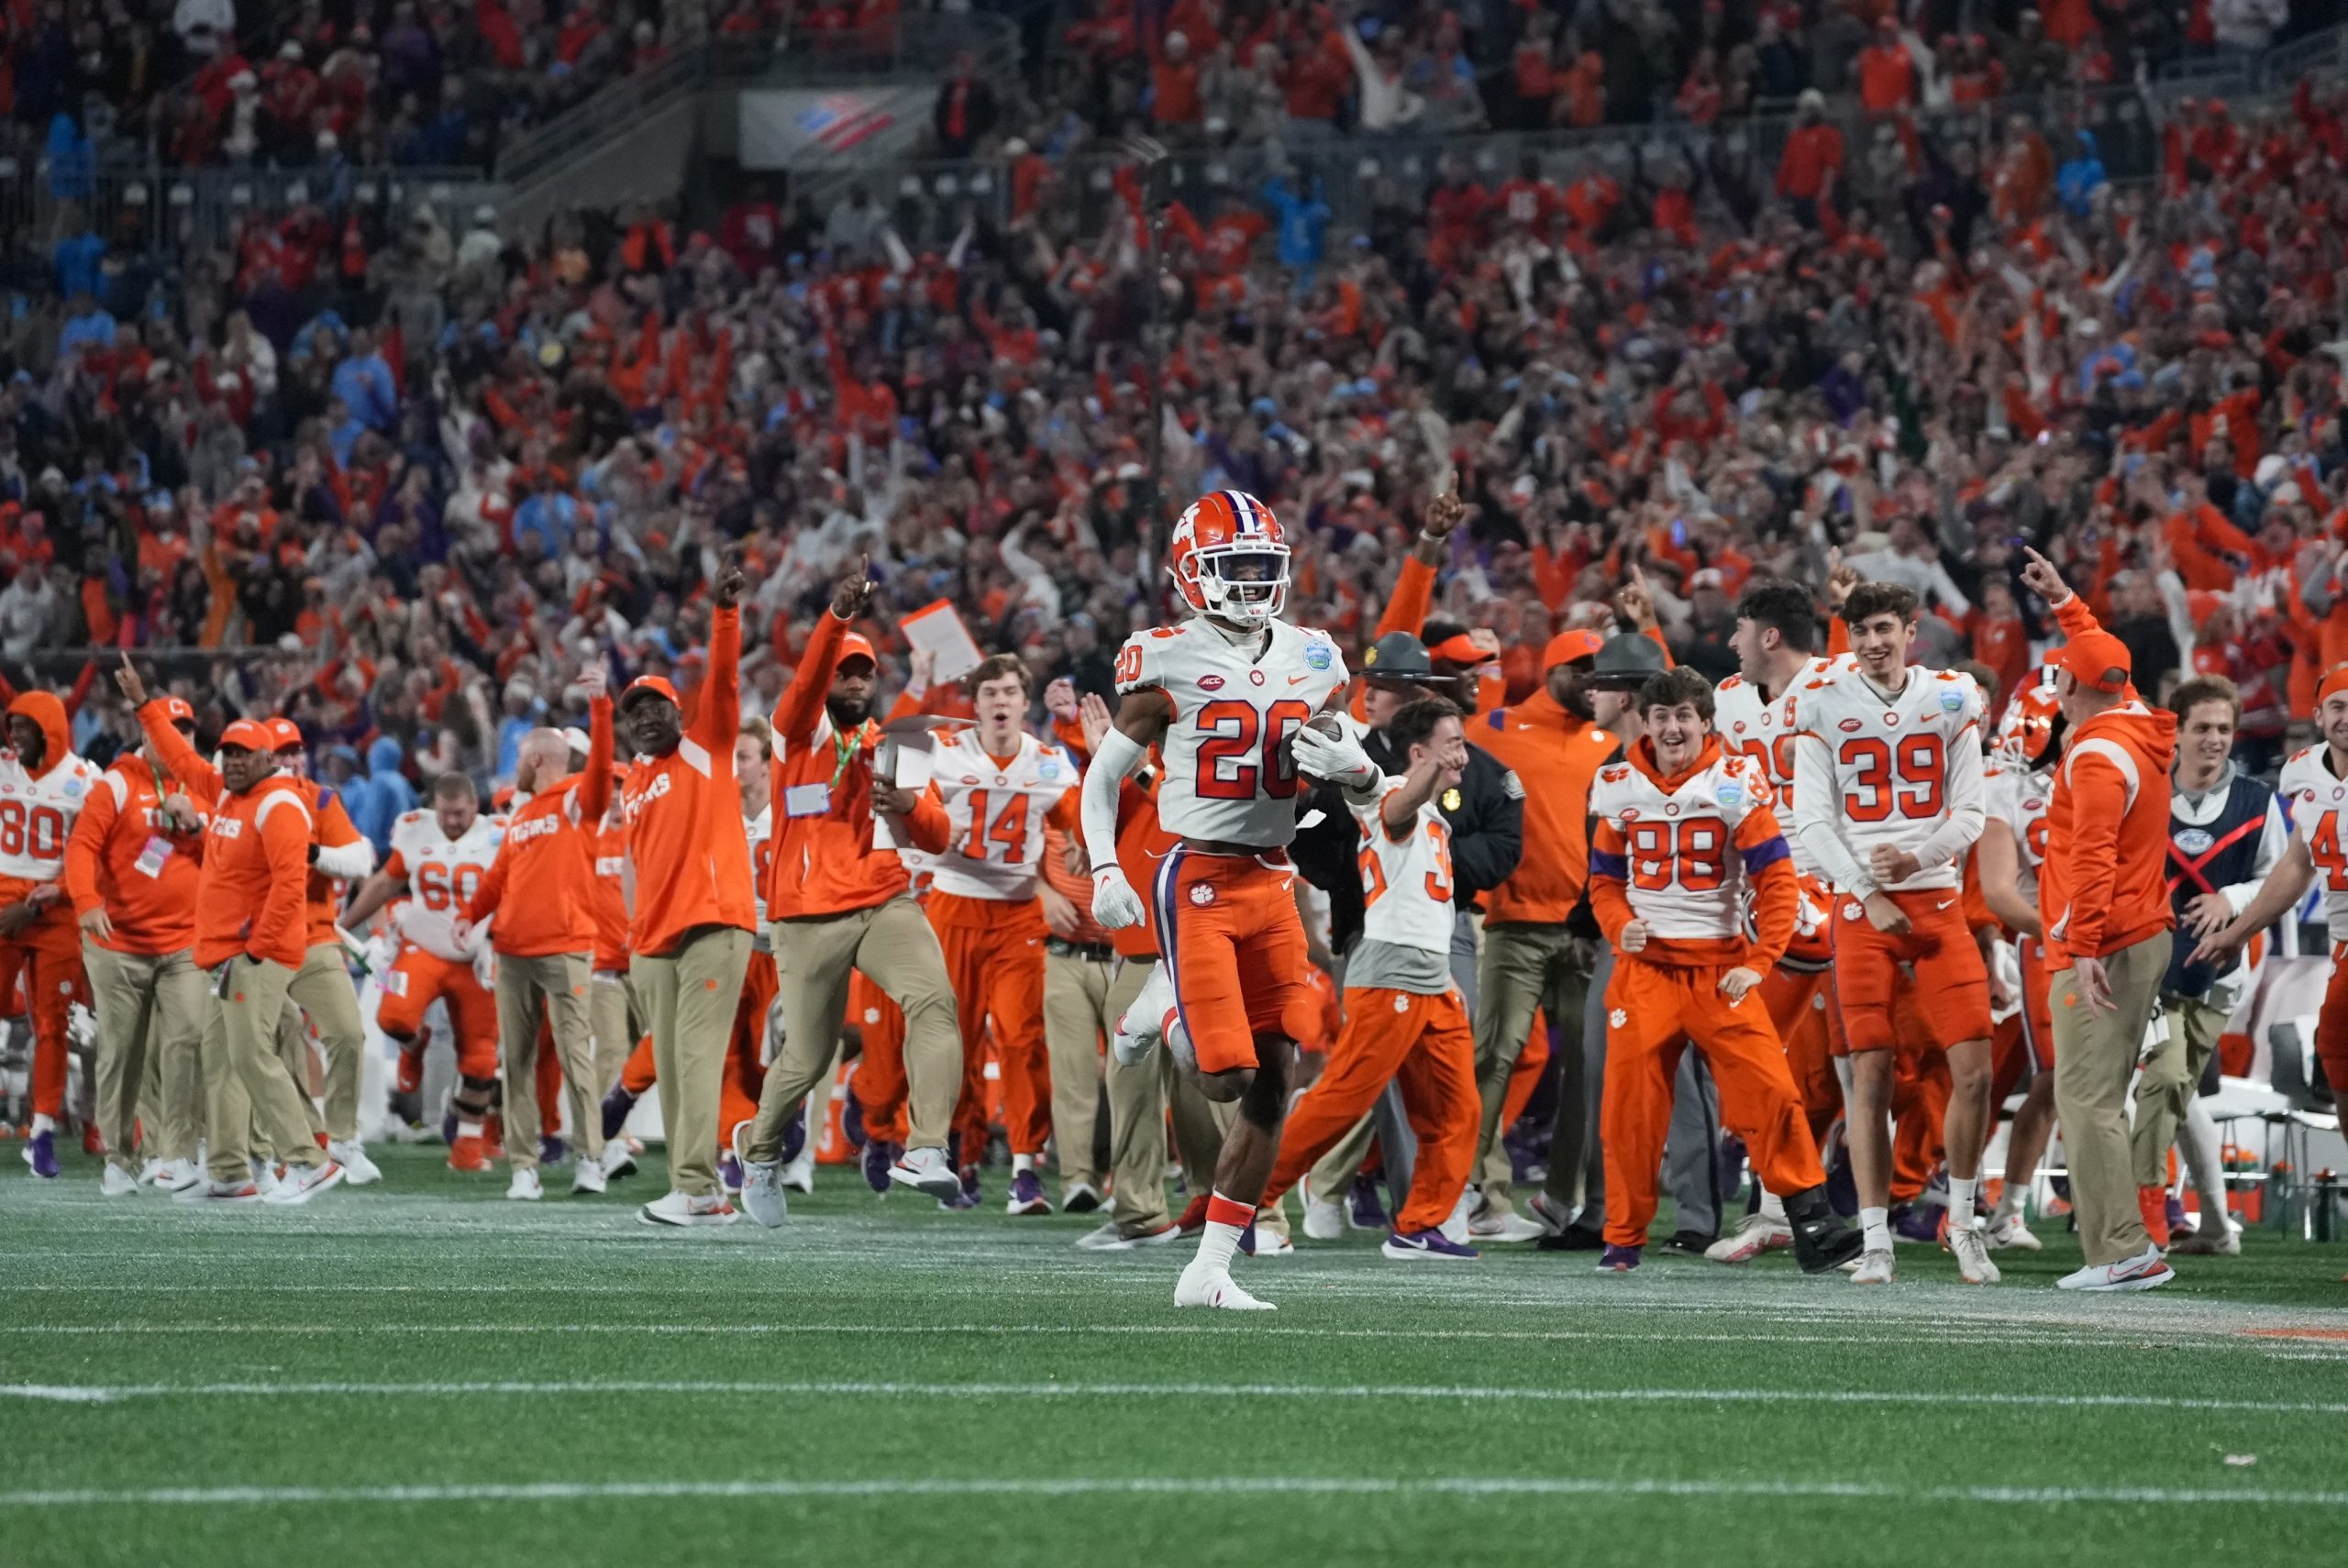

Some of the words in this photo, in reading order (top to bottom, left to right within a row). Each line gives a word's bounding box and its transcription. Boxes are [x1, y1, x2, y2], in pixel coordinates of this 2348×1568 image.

[169, 700, 184, 714] C
[1195, 700, 1311, 801] 20
[1839, 731, 1944, 823] 39
[0, 799, 63, 860] 80
[962, 789, 1029, 864] 14
[1624, 816, 1729, 892] 88
[418, 861, 485, 911] 60
